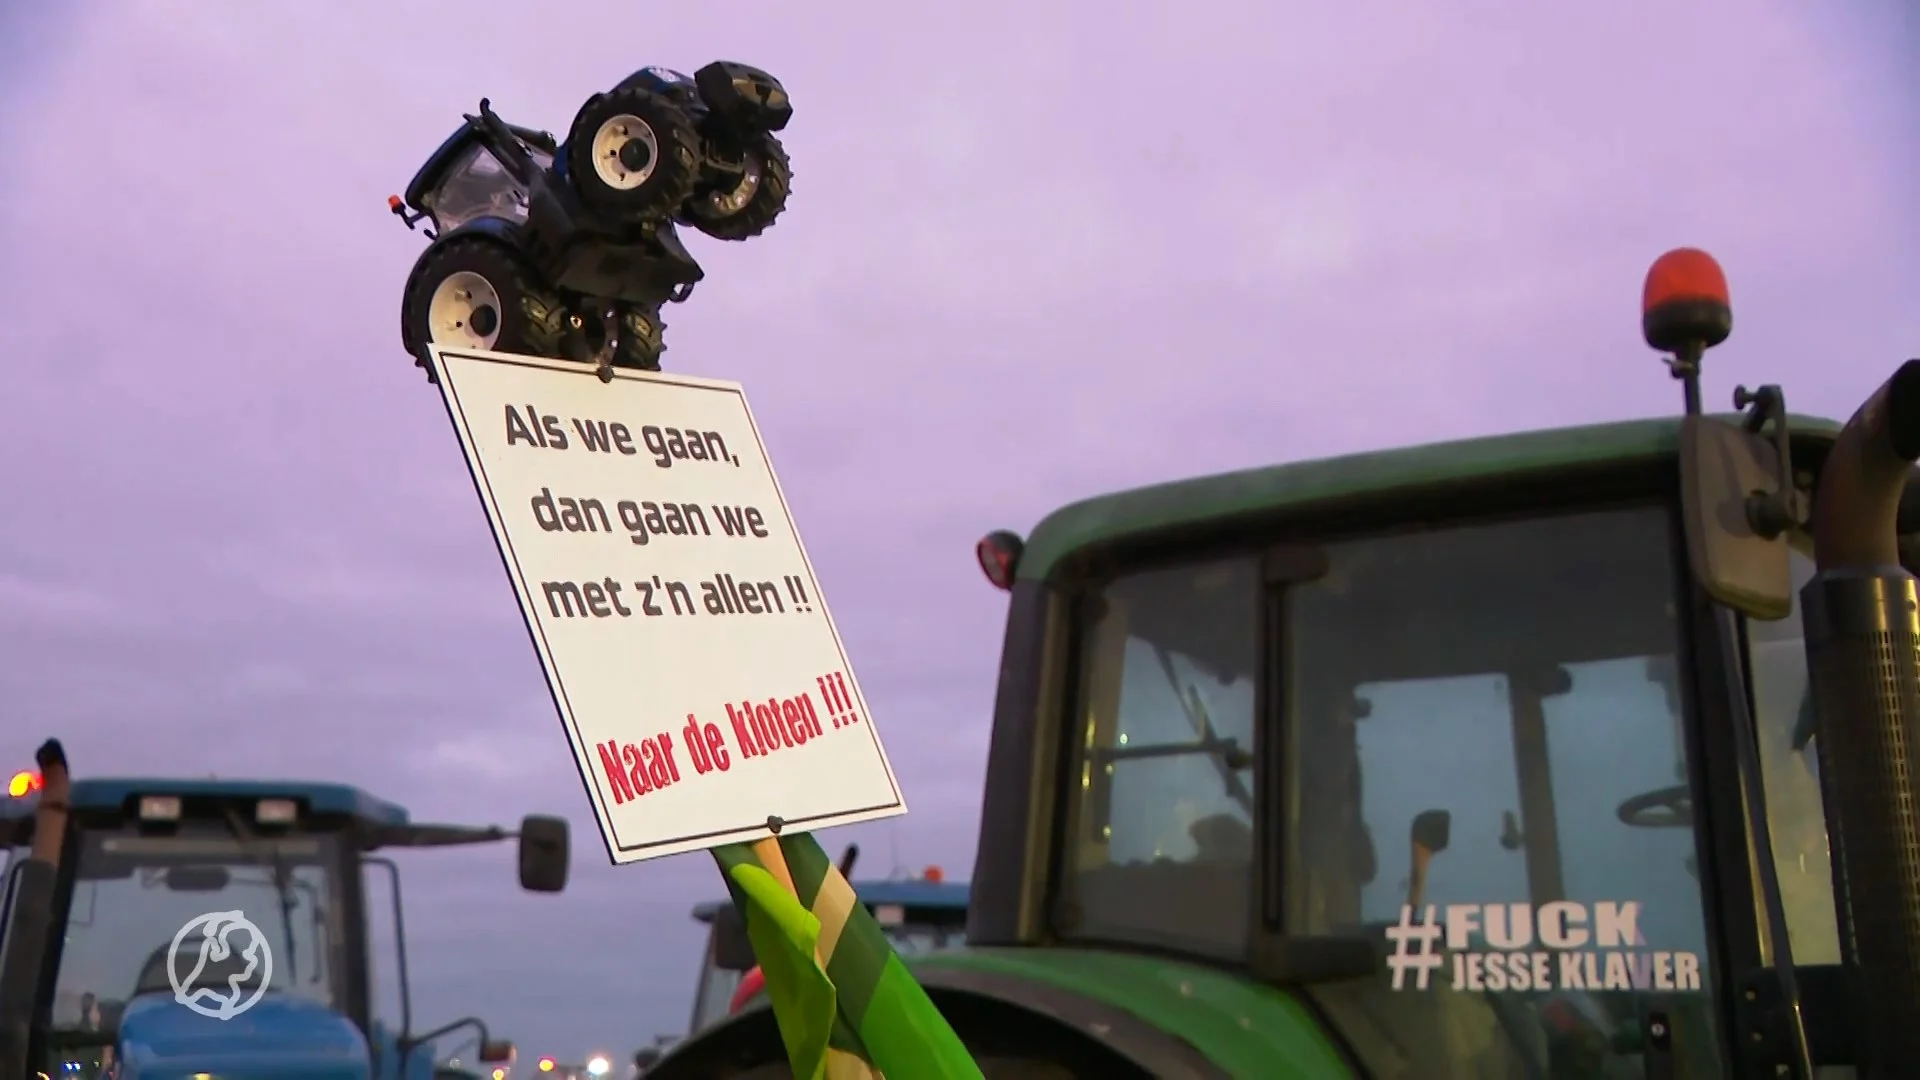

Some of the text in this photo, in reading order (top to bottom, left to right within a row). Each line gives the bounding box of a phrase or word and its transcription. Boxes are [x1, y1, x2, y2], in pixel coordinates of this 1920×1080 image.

[505, 404, 740, 468] Als we gaan,
[531, 488, 768, 545] dan gaan we
[541, 574, 812, 618] met z'n allen !!
[597, 672, 858, 805] Naar de kloten !!!
[1452, 951, 1700, 990] JESSE KLAVER
